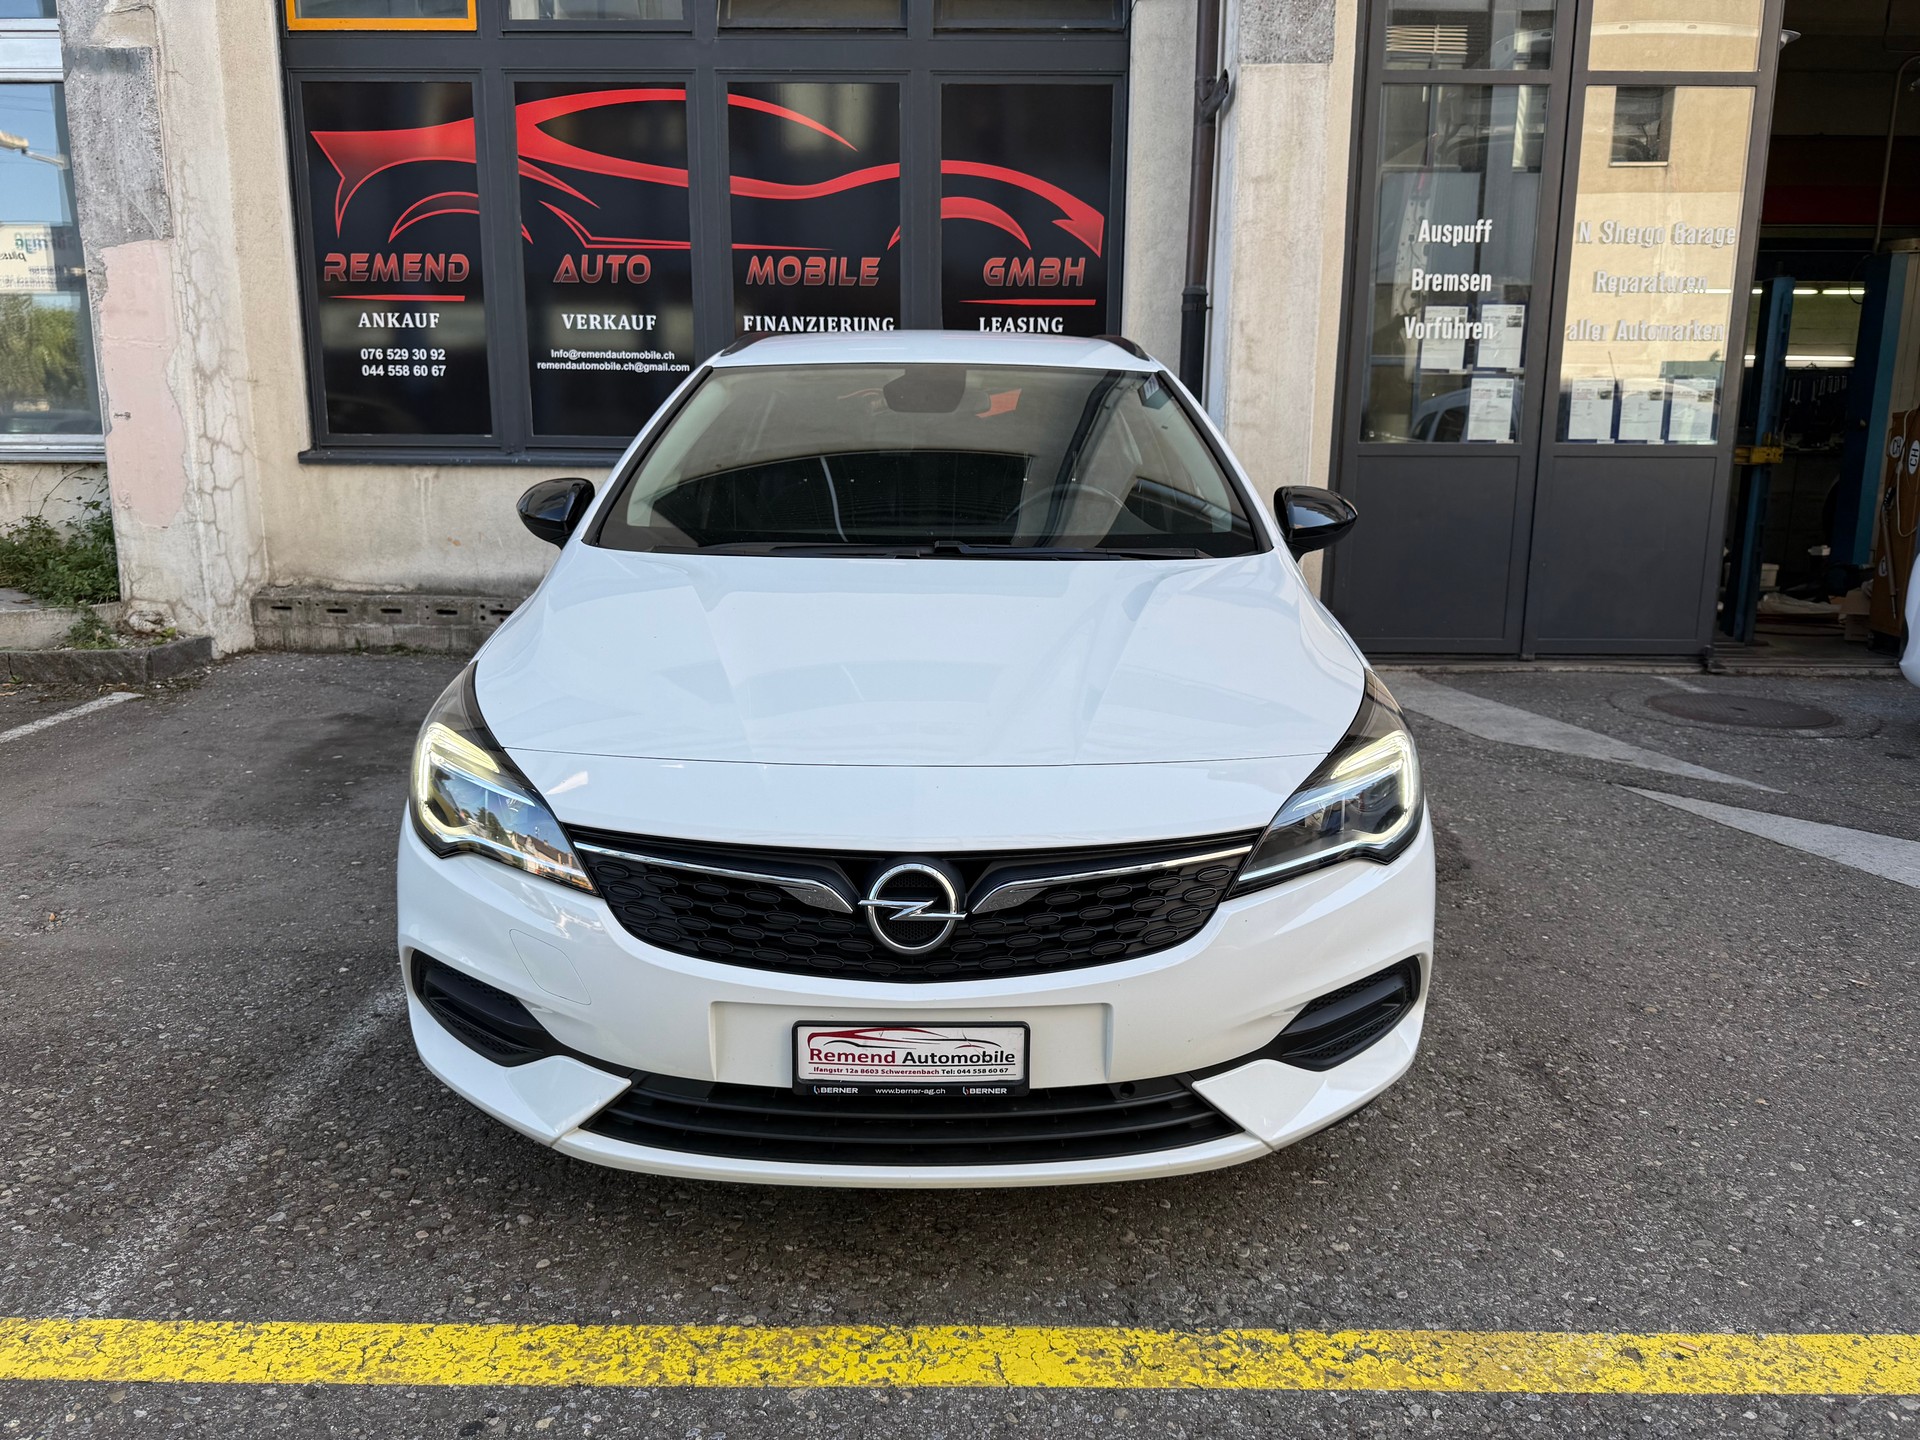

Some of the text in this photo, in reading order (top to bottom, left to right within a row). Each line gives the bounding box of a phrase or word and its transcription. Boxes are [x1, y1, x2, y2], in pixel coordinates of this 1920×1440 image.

[1418, 219, 1493, 247] Auspuff
[1599, 220, 1666, 248] Shergo
[1672, 222, 1737, 249] Garage
[323, 252, 1086, 287] REMEND AUTO MOBILE GMBH
[1411, 268, 1492, 292] Bremsen
[1593, 271, 1708, 296] Reparaturen
[358, 312, 440, 329] ANKAUF
[562, 313, 657, 331] VERKAUF
[743, 315, 895, 332] FINANZIERUNG
[979, 316, 1065, 333] LEASING
[1404, 316, 1494, 340] Vorführen
[1566, 318, 1725, 342] aller Automarken
[360, 348, 446, 361] 076 529 30 92
[550, 349, 675, 361] Info@remendautomobile.ch
[361, 364, 447, 377] 044 558 60 67
[536, 361, 690, 373] remendautomobile.ch@gmail.com
[1910, 448, 1919, 467] CH
[809, 1048, 1015, 1064] Remend Automobile
[875, 1088, 946, 1096] www.berner-ag.ch
